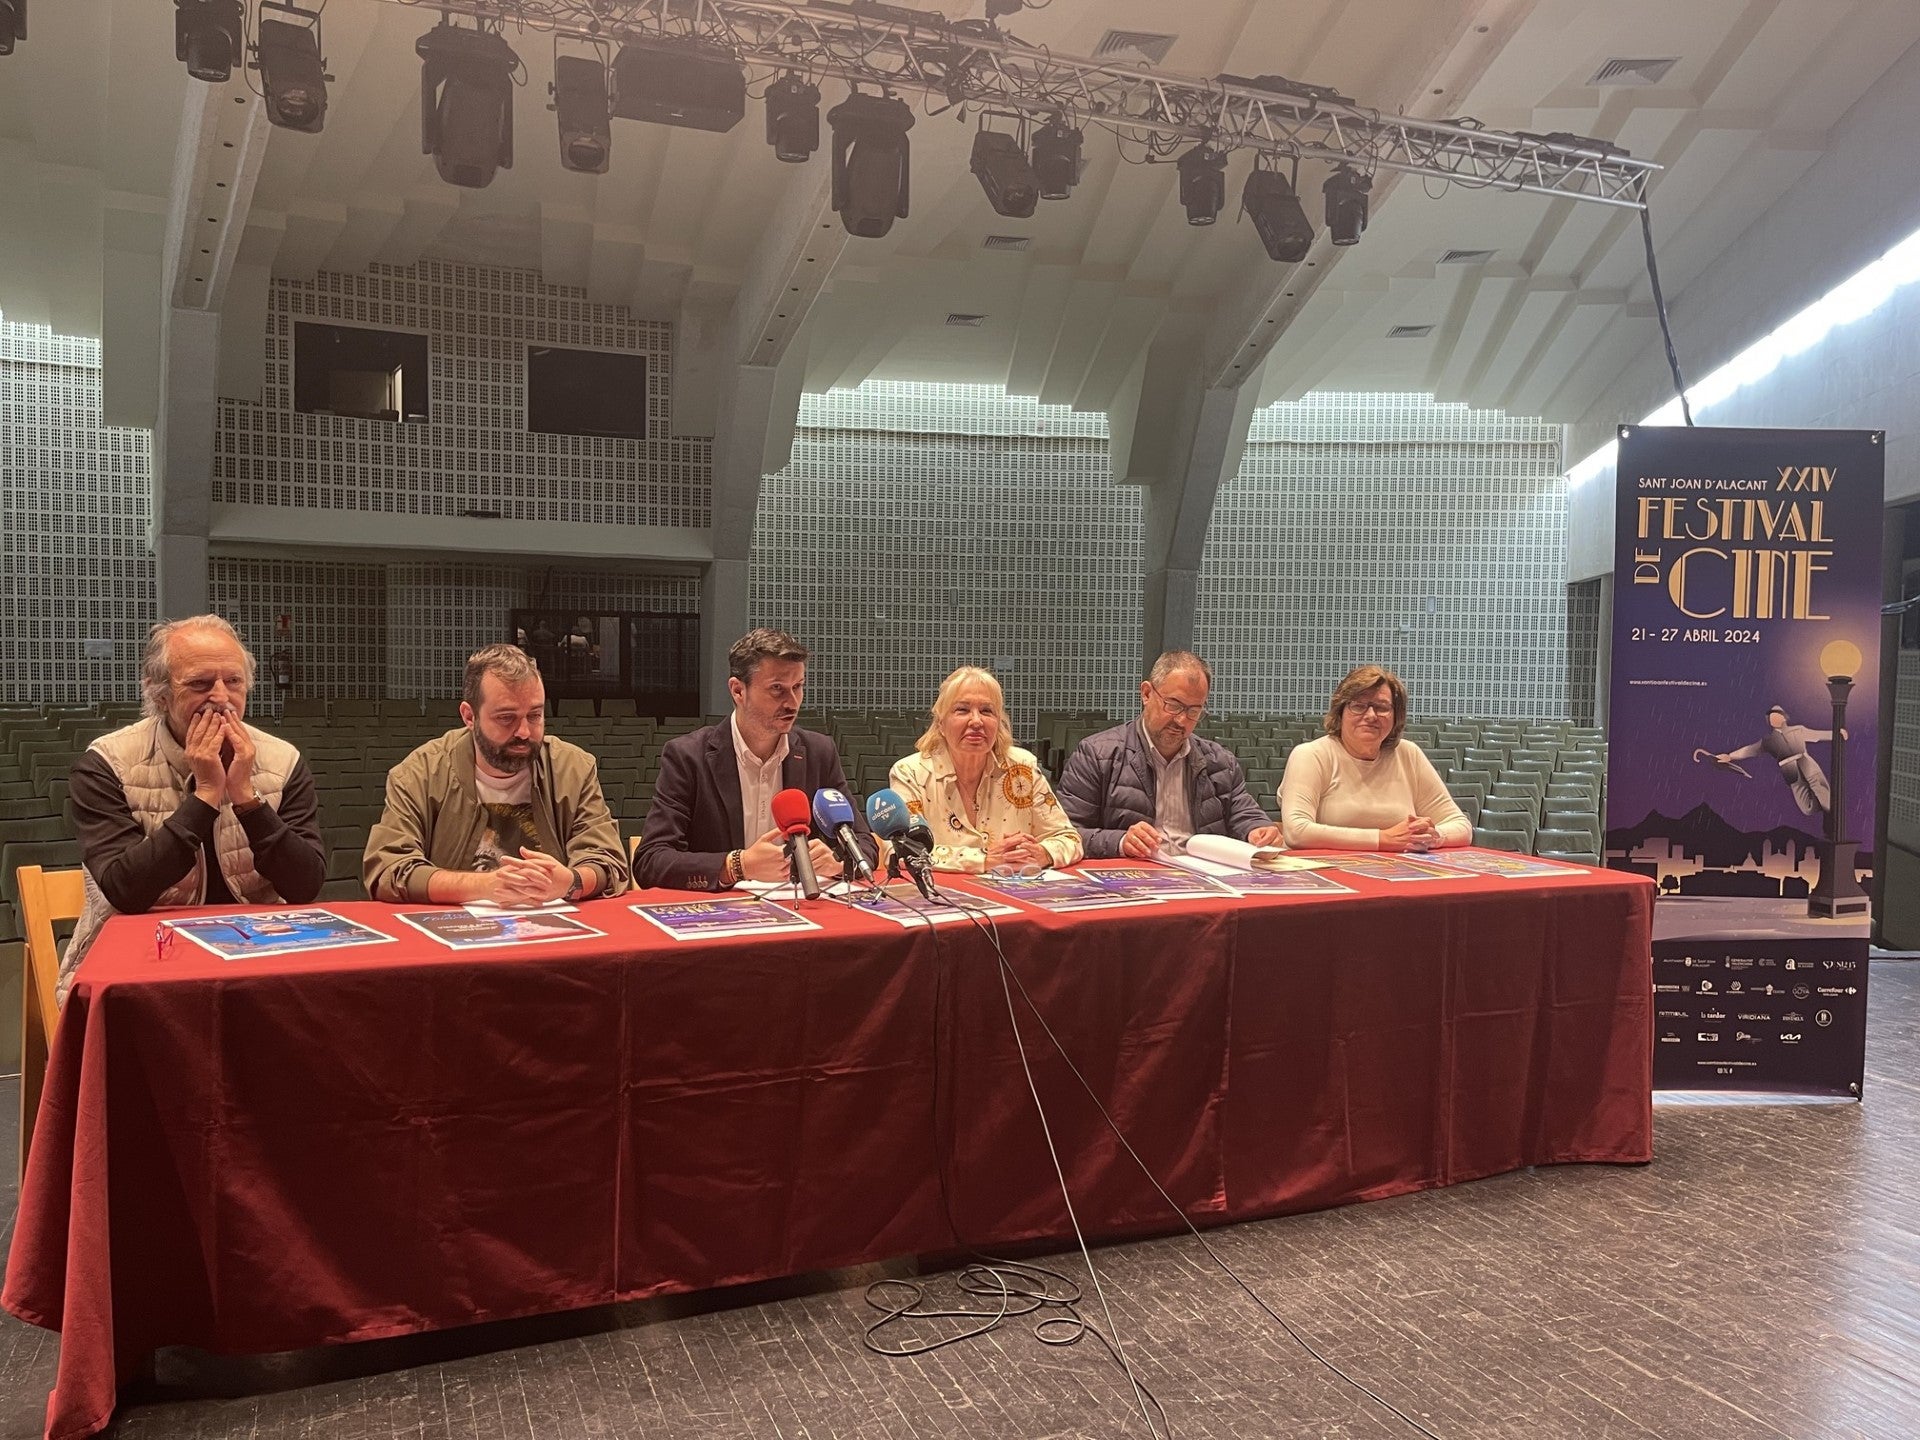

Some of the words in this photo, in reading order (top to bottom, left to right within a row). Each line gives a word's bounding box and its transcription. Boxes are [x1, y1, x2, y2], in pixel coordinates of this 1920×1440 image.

[1638, 477, 1667, 489] SANT
[1670, 478, 1702, 490] JOAN
[1776, 466, 1838, 492] XXIV
[1637, 496, 1834, 542] FESTIVAL
[1634, 547, 1661, 584] DE
[1668, 547, 1833, 619] CINE
[1631, 627, 1646, 641] 21
[1661, 628, 1679, 641] 27
[1683, 629, 1720, 642] ABRIL
[1724, 630, 1761, 643] 2024
[1817, 986, 1844, 994] Carrefour
